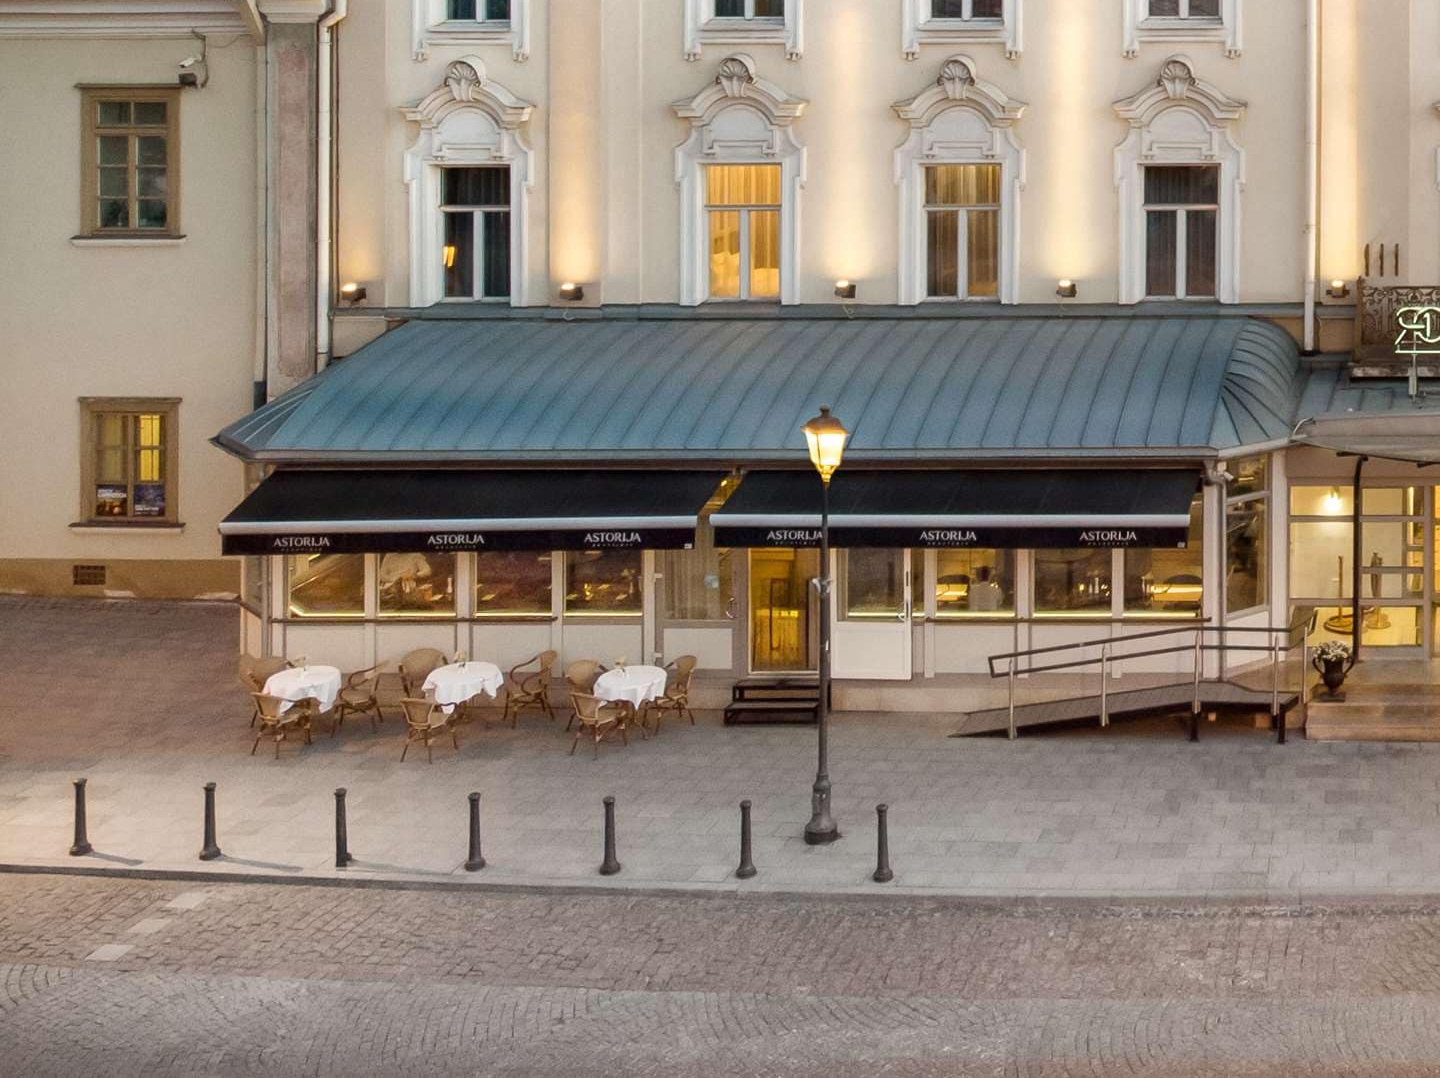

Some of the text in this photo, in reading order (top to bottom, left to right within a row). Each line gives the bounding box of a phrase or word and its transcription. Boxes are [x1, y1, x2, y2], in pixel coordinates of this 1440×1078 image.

[427, 534, 485, 545] ASTORIJA
[584, 532, 641, 543] ASTORIJA
[766, 529, 824, 541] ASTORIJA
[919, 529, 977, 541] ASTORIJA
[1080, 530, 1137, 541] ASTORIJA
[273, 537, 330, 547] ASTORIJA
